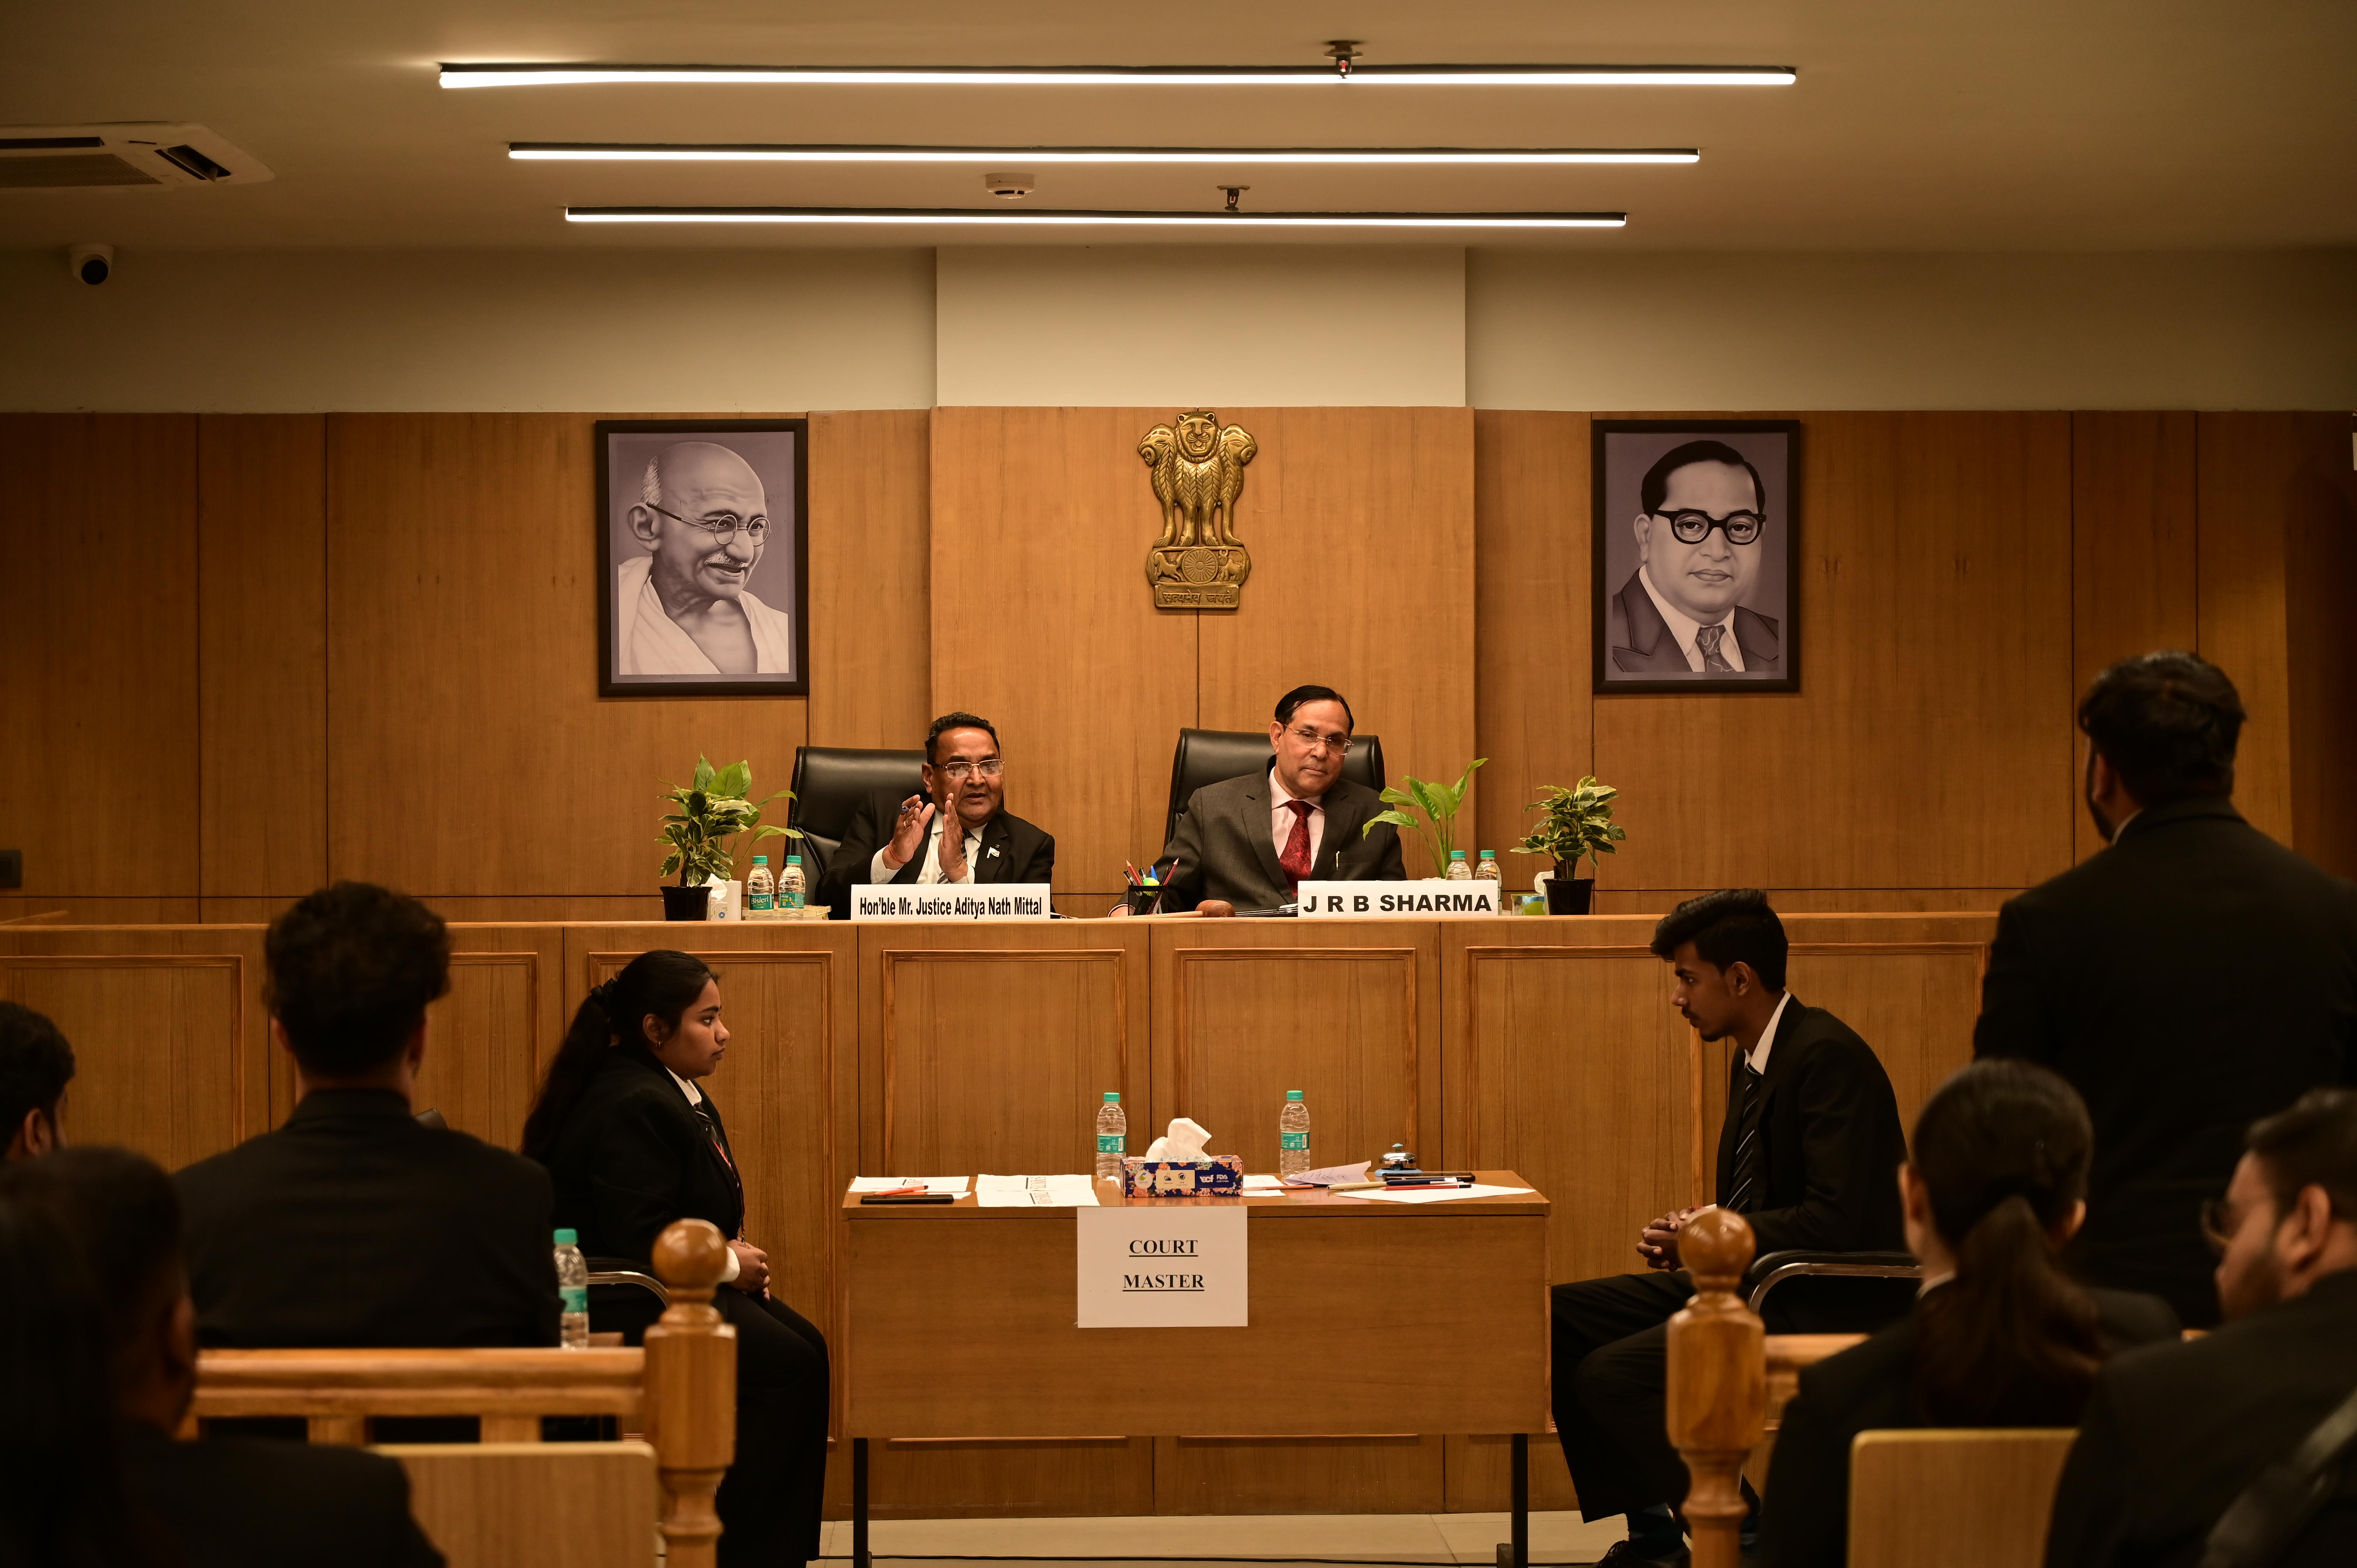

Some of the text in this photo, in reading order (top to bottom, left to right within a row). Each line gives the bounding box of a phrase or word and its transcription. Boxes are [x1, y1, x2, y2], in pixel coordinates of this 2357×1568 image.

[1163, 589, 1232, 604] सत्यमेव जयते
[751, 896, 769, 904] Bisleri
[1303, 895, 1492, 913] J R B SHARMA
[860, 897, 1042, 919] Hon'ble Mr. Justice Aditya Nath Mittal
[1129, 1240, 1198, 1254] COURT
[1123, 1274, 1205, 1288] MASTER
